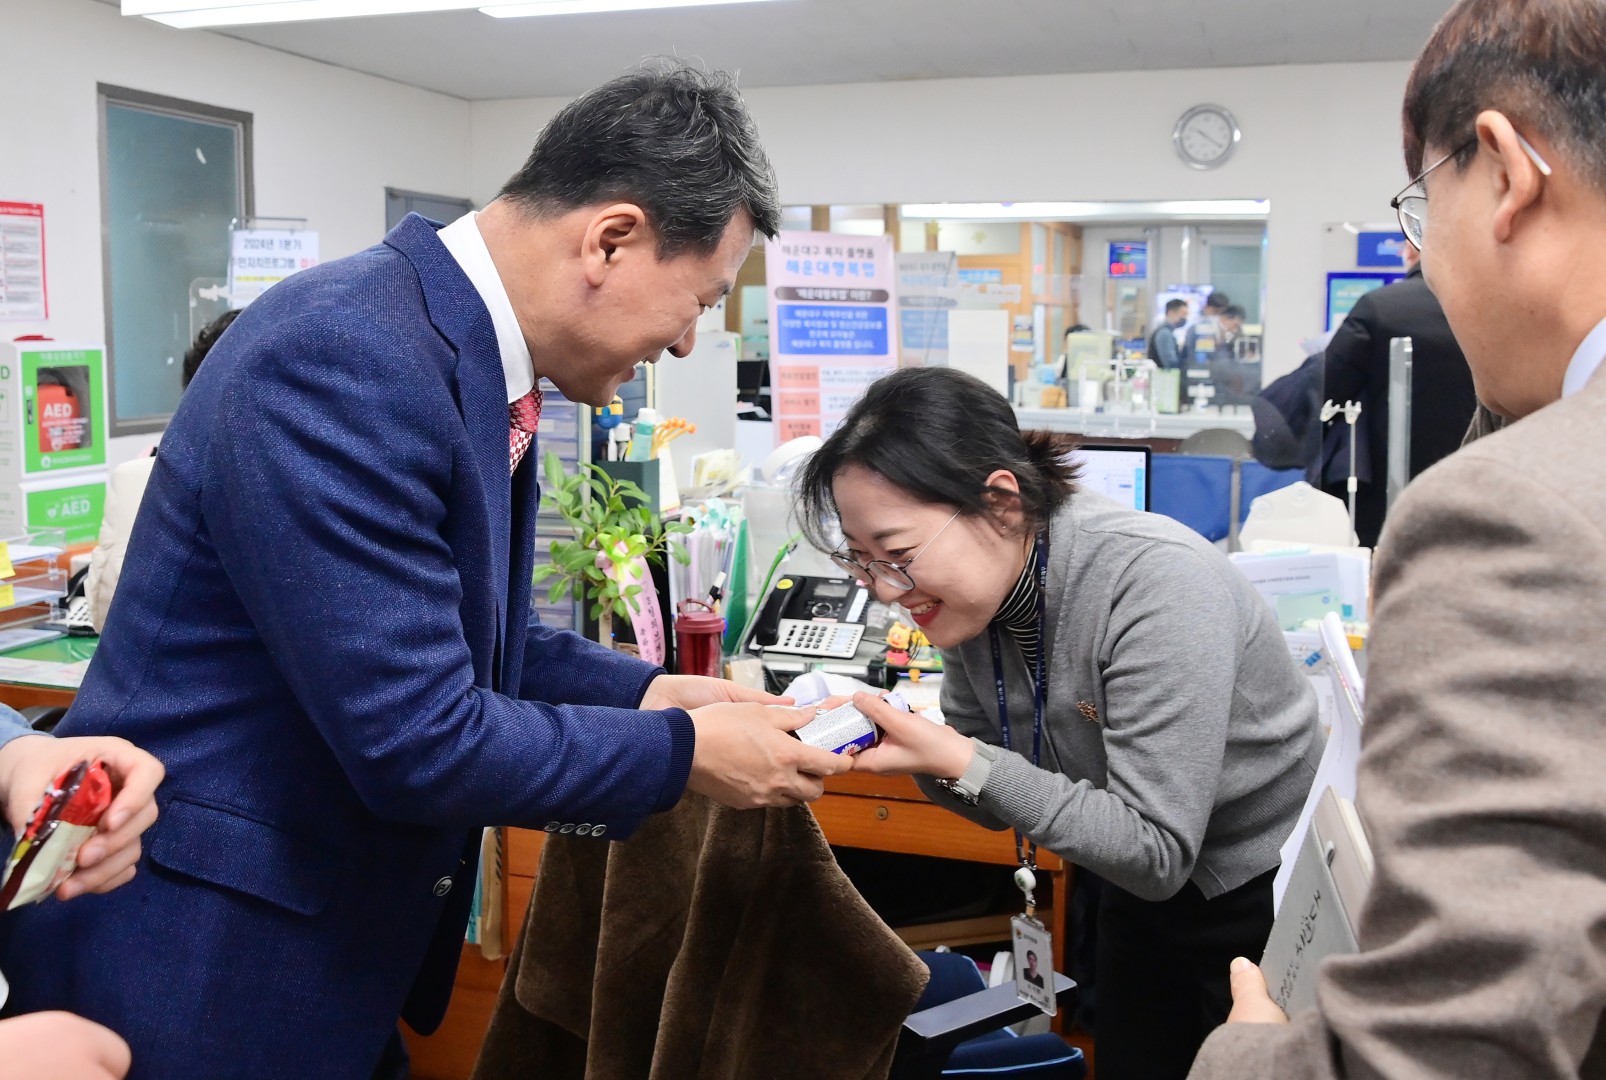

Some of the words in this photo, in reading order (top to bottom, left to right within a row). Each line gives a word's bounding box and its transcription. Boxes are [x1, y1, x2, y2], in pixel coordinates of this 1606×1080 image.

[244, 238, 274, 250] 2024년
[781, 244, 820, 256] 해운대구
[825, 246, 843, 256] 복지
[43, 403, 73, 419] AED
[62, 499, 90, 518] AED
